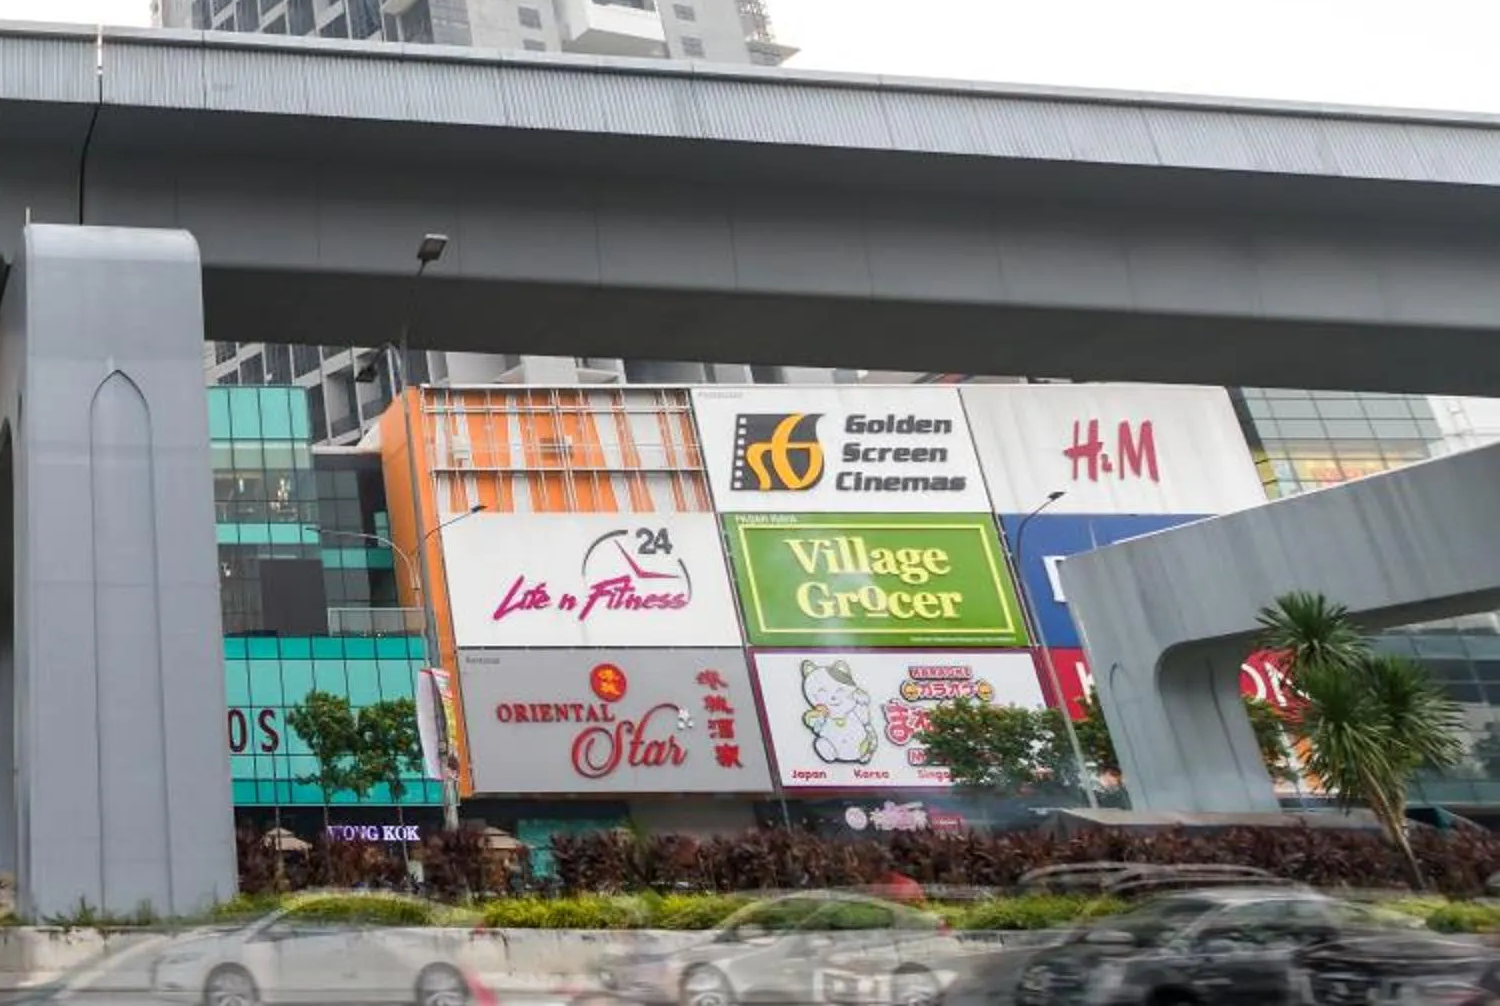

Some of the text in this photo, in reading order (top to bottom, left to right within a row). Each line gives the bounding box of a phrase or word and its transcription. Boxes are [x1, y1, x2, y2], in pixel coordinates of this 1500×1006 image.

[844, 413, 953, 435] Golden
[841, 441, 948, 463] Screen
[1064, 419, 1161, 483] H&M
[835, 471, 967, 492] Cinemas
[636, 527, 673, 555] 24
[783, 536, 953, 584] Village
[493, 574, 689, 621] Life n Fitness
[796, 581, 964, 619] Grocer
[495, 702, 615, 723] ORIENTAL
[571, 703, 688, 779] Star
[791, 769, 952, 782] Japan Korea Singa
[382, 825, 420, 841] KOK
